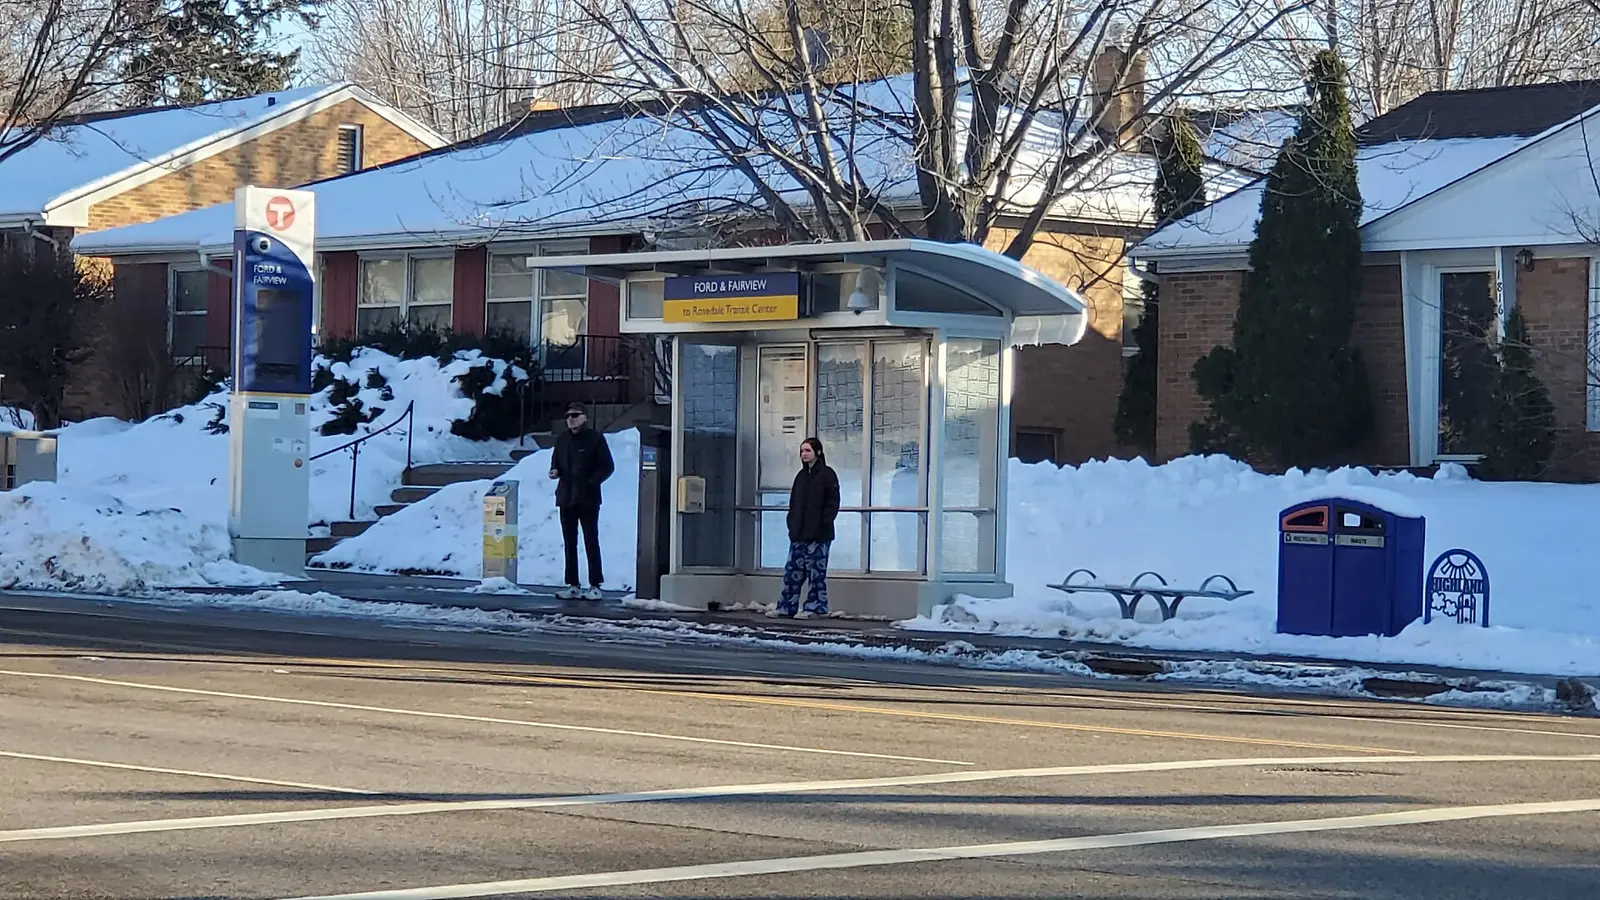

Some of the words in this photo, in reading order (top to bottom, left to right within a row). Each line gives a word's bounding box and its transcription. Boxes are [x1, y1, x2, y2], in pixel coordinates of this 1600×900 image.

[269, 203, 293, 227] T
[253, 264, 275, 273] FORD
[253, 275, 287, 285] FAIRVIEW
[694, 281, 718, 293] FORD
[719, 281, 726, 292] &
[728, 279, 767, 291] FAIRVIEW
[683, 308, 691, 316] to
[692, 305, 724, 316] Rosedale
[726, 304, 750, 314] Transit
[751, 303, 777, 314] Center
[1431, 578, 1483, 593] HIGHLAND
